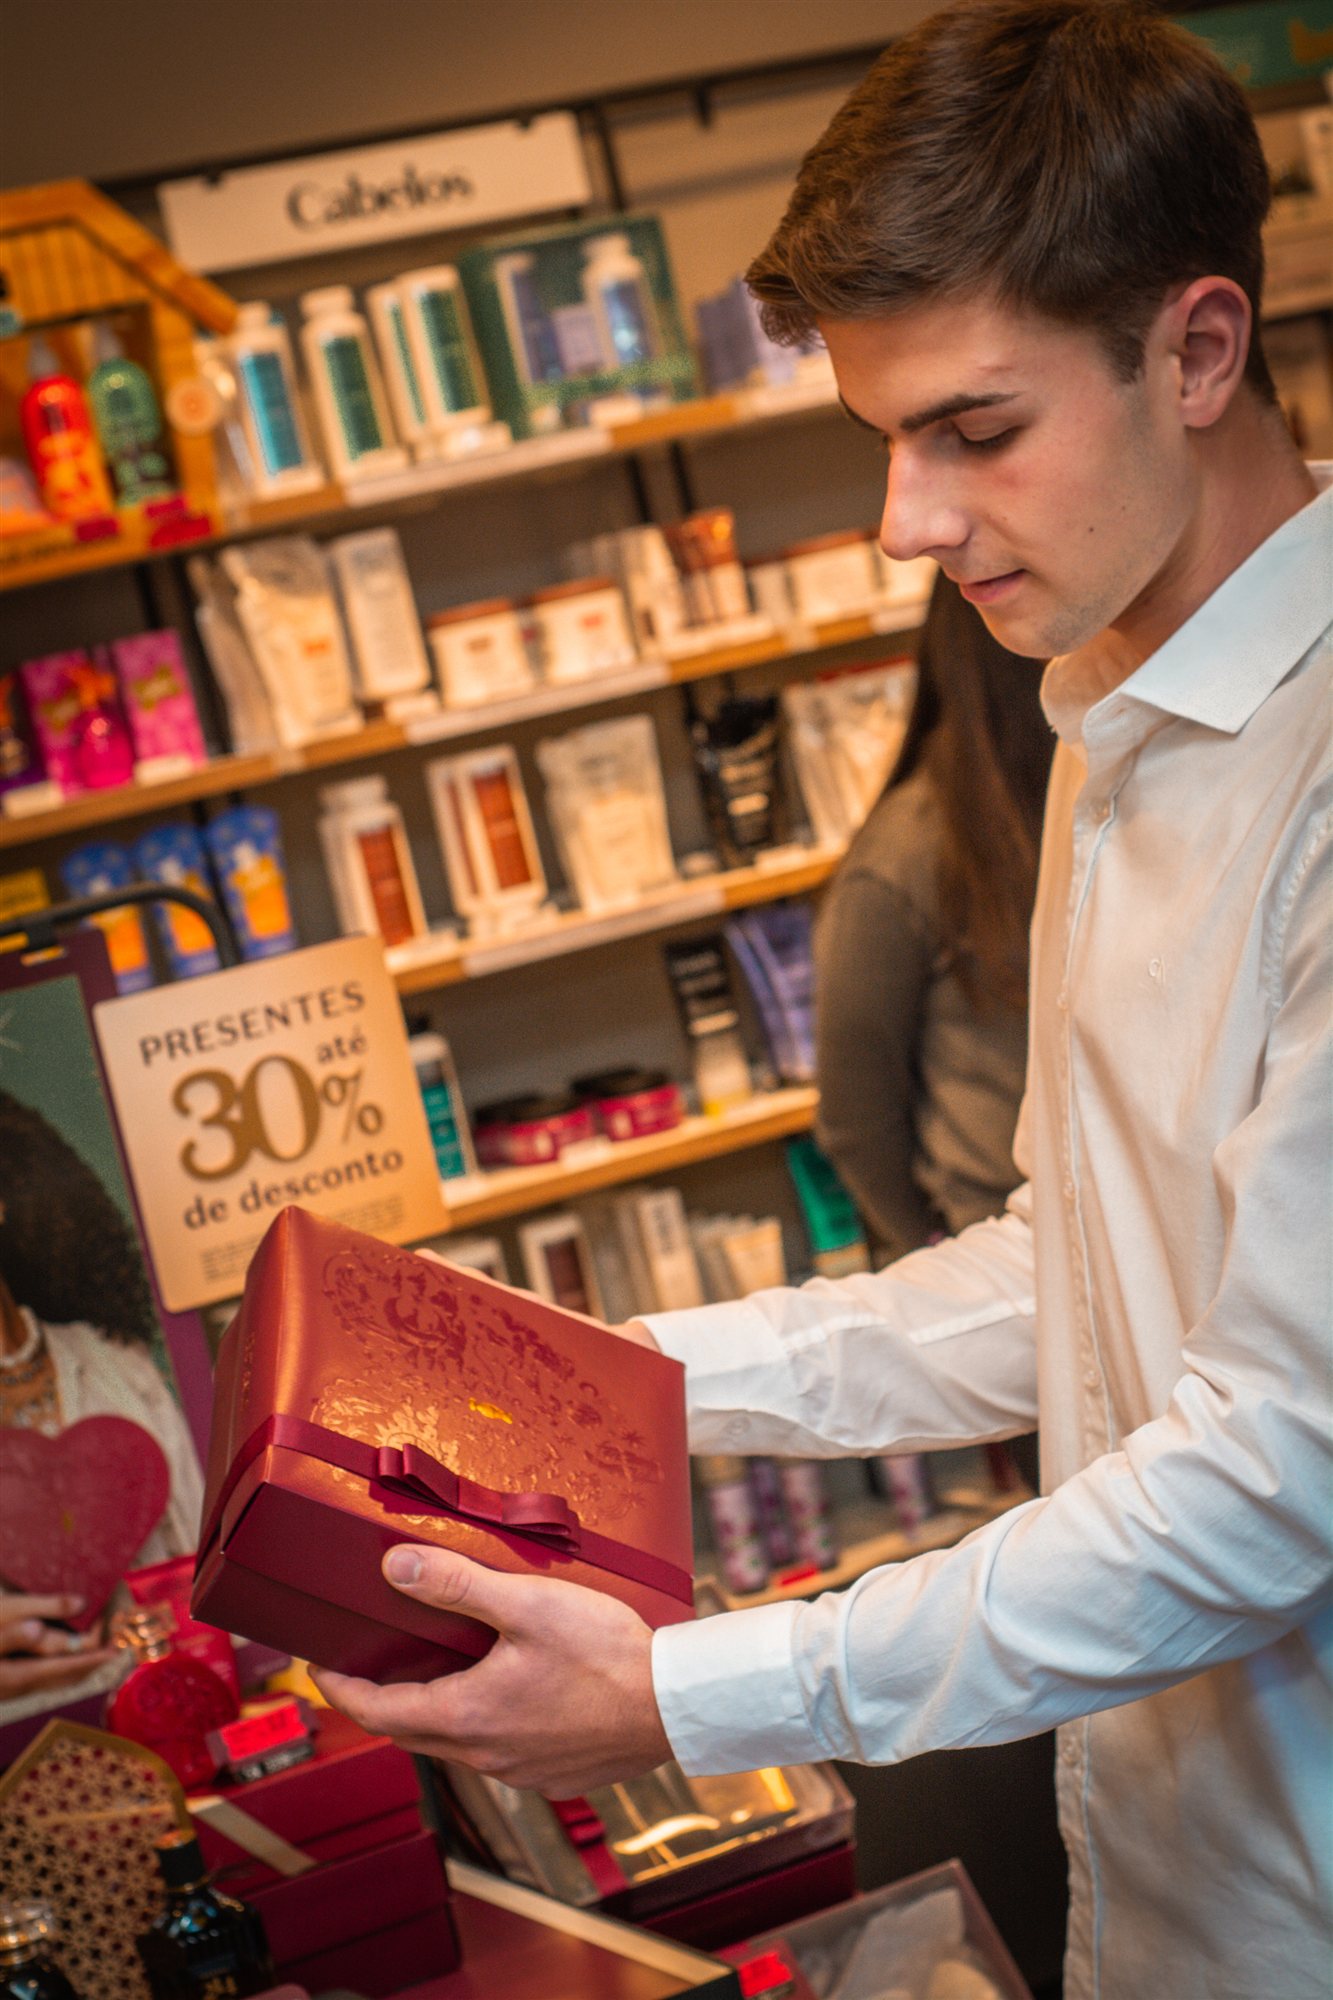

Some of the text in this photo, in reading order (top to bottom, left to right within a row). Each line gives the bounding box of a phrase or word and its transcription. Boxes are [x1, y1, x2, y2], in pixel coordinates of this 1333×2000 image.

[286, 163, 474, 231] Cabelos
[139, 983, 365, 1067] PRESENTES
[317, 1026, 367, 1063] até
[172, 1054, 385, 1181] 30%
[184, 1150, 403, 1230] de desconto
